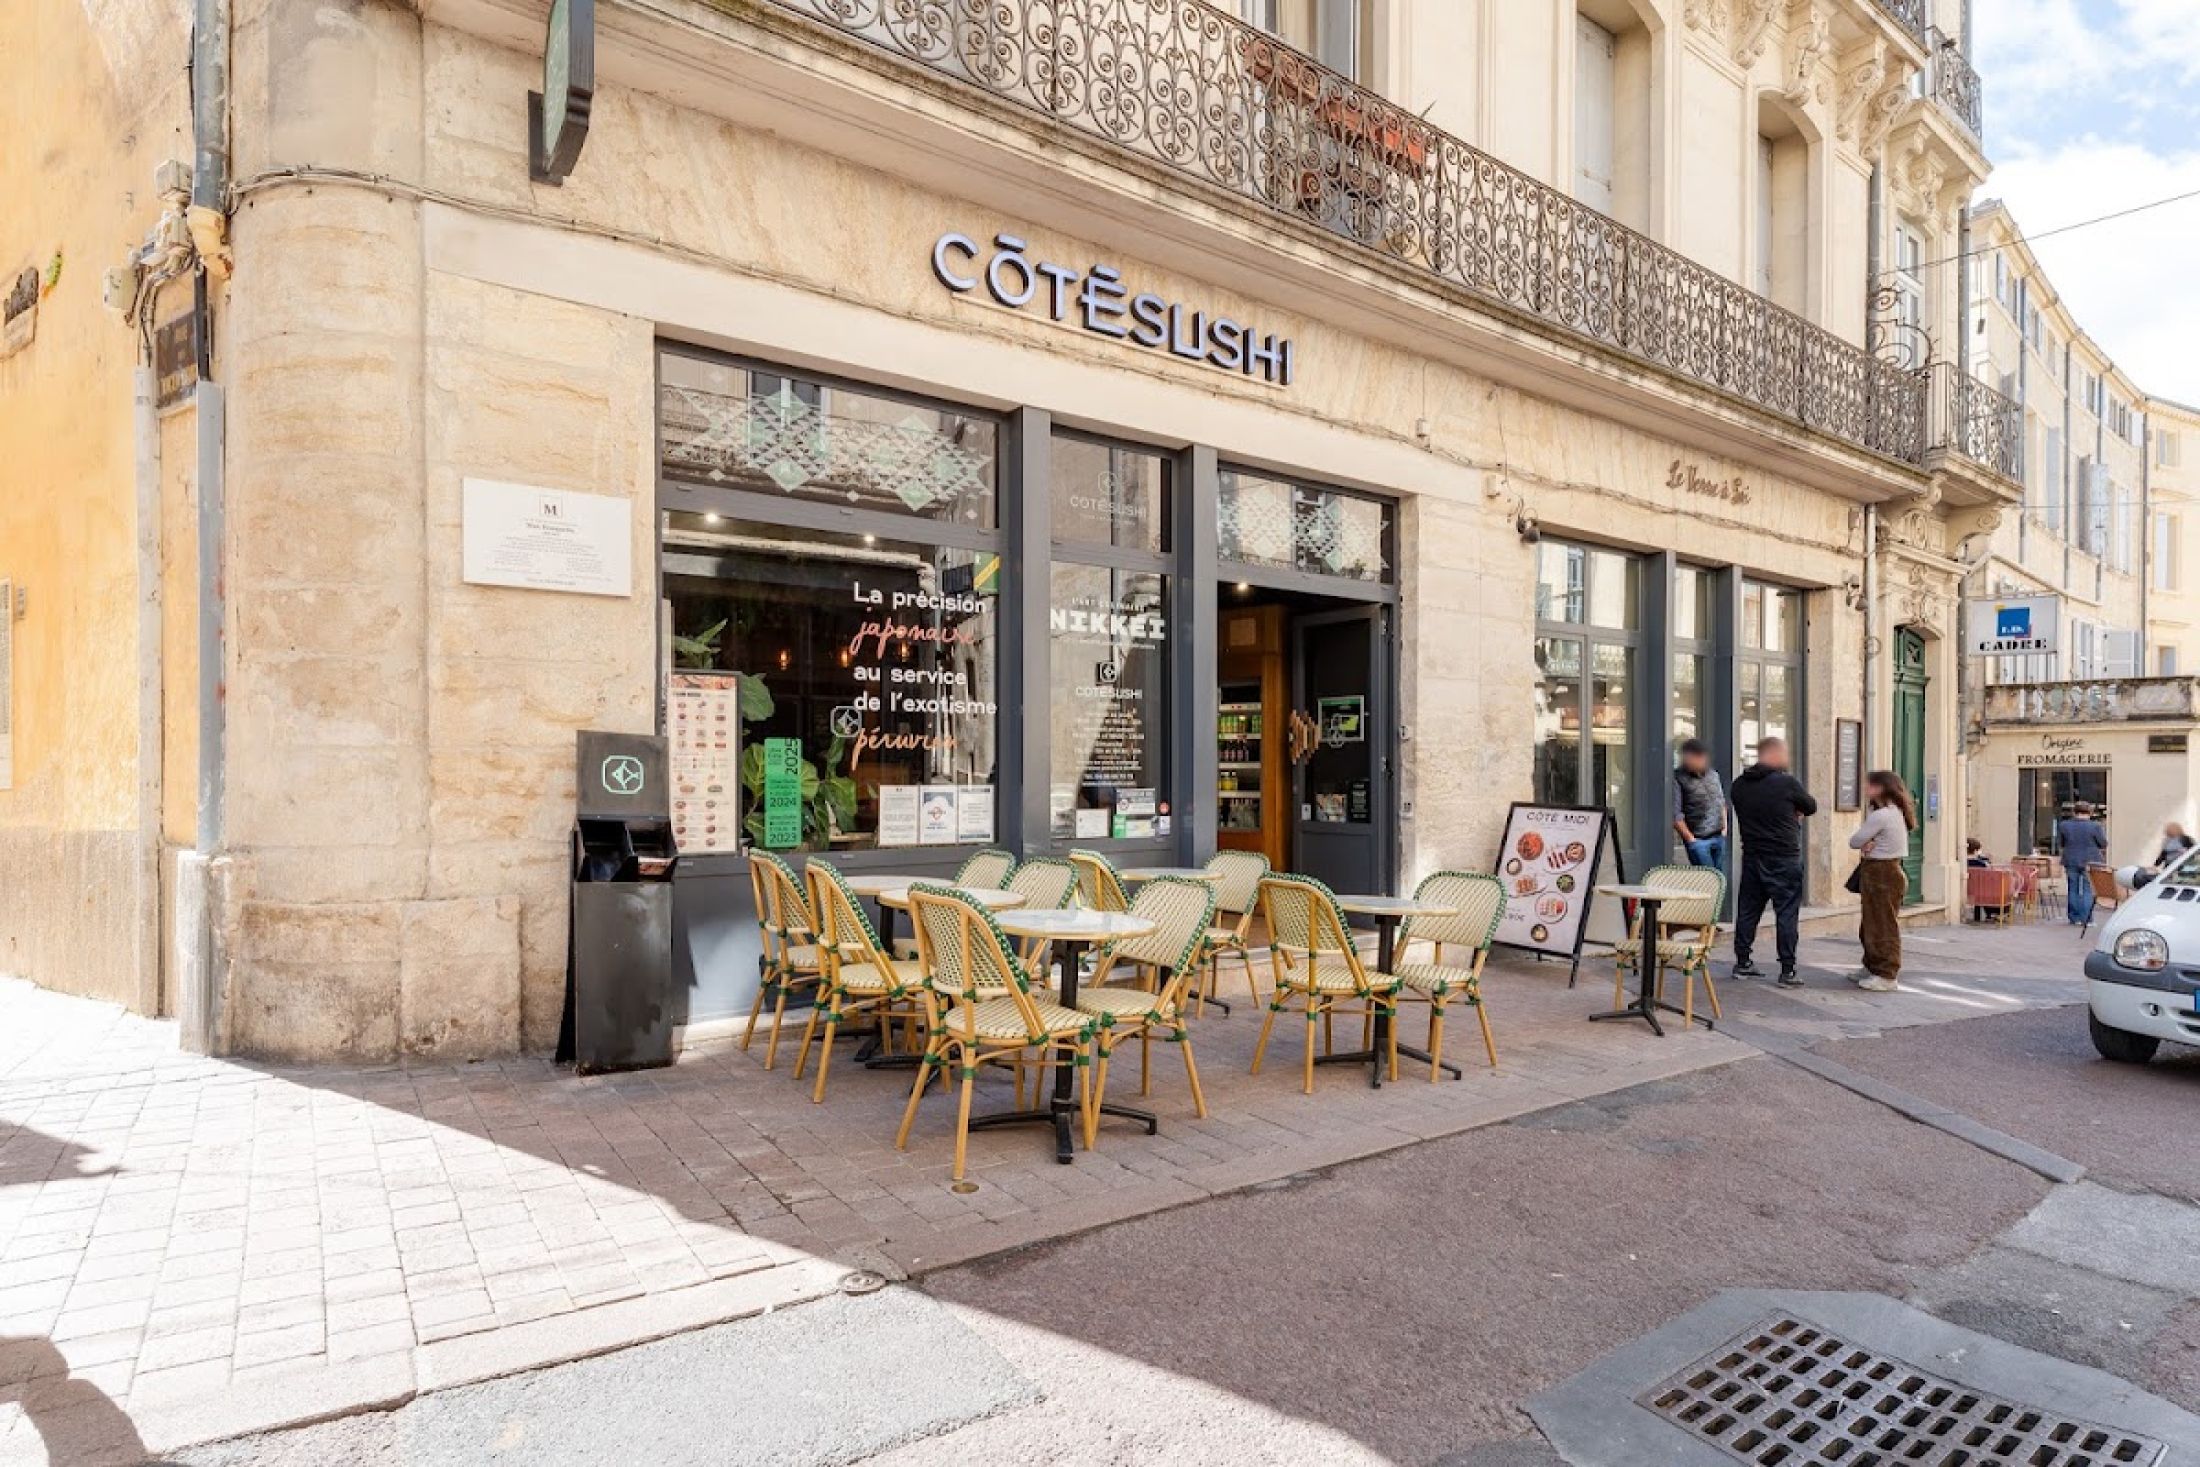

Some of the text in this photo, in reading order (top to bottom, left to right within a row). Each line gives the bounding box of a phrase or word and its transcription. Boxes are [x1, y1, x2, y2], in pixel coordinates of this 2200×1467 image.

[853, 581, 986, 613] La précision
[850, 606, 974, 660] japonaise
[1980, 638, 2046, 651] CADRE
[854, 665, 966, 684] au service
[854, 691, 997, 714] de l'exotisme
[852, 724, 958, 771] péruvien
[2042, 734, 2085, 752] Origine
[785, 738, 798, 775] 2025
[2018, 753, 2112, 764] FROMAGERIE
[769, 797, 797, 808] 2024
[1562, 814, 1590, 825] MIDI
[769, 833, 797, 844] 2023
